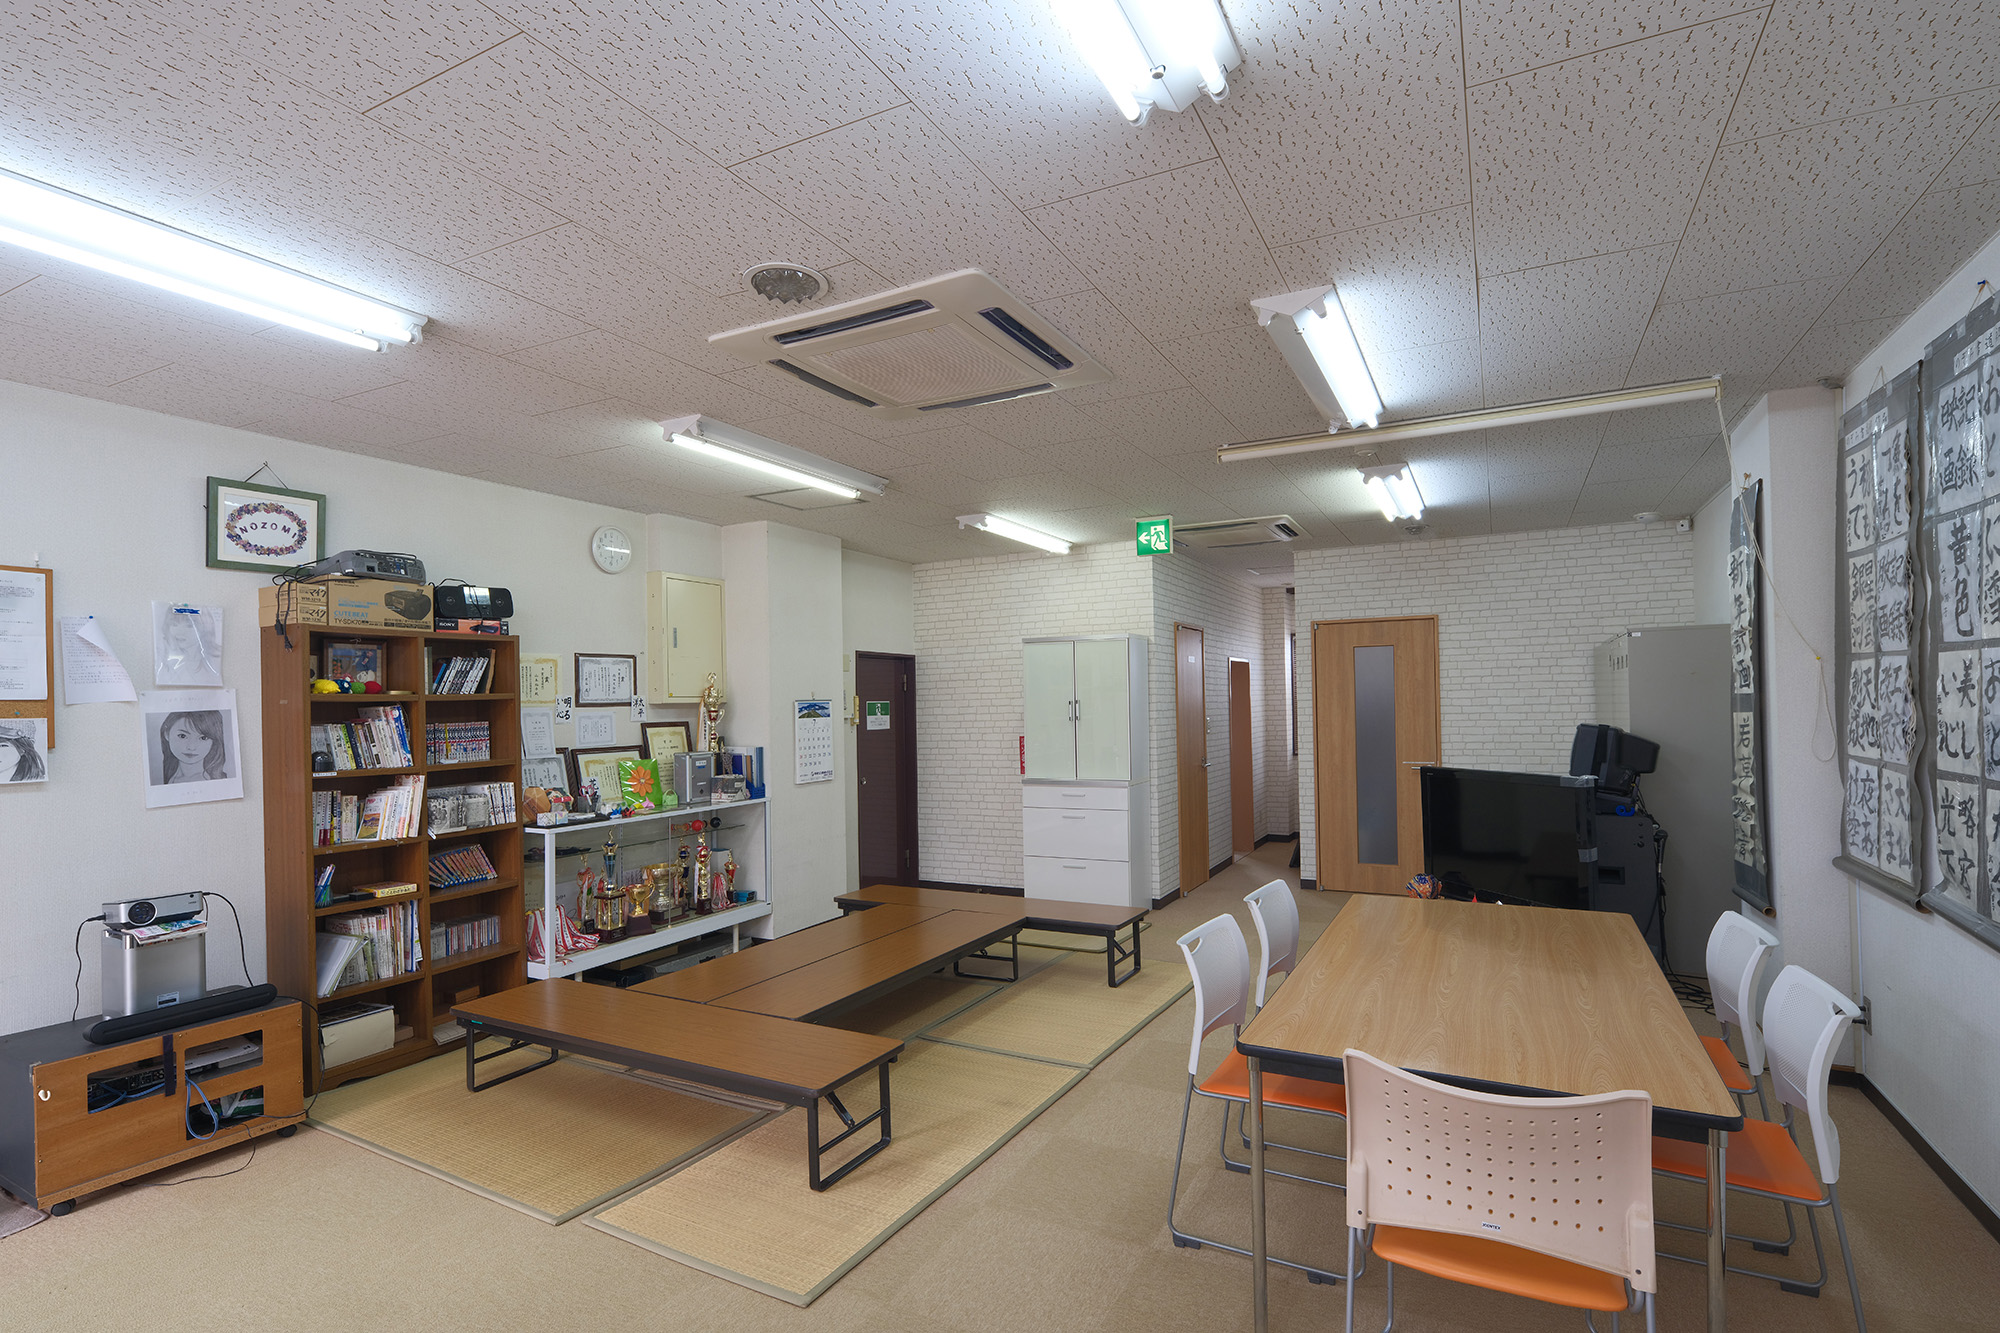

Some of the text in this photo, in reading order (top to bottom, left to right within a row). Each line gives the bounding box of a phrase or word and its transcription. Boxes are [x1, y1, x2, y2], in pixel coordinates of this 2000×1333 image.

[239, 522, 297, 538] NOZOMI
[1947, 517, 1975, 637] 黄色
[309, 588, 327, 598] マイク
[308, 609, 326, 618] マイク
[563, 697, 572, 720] 明る
